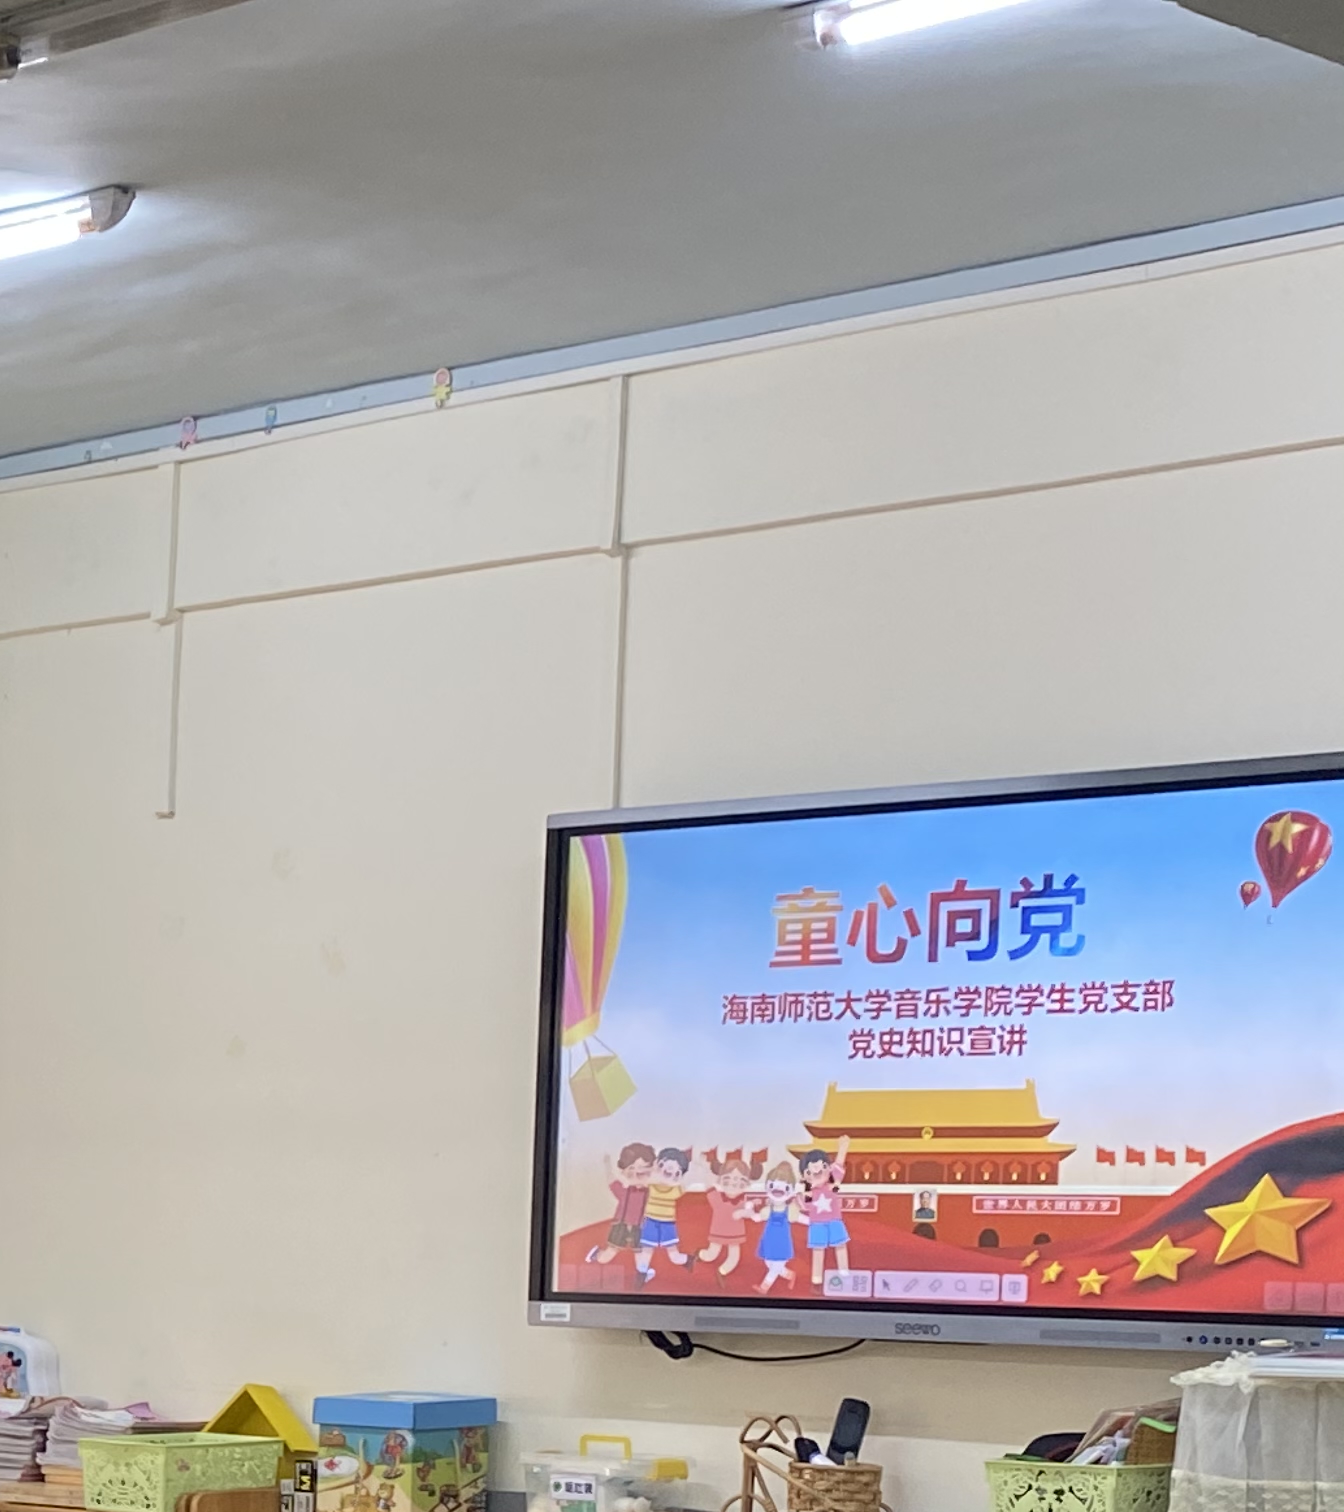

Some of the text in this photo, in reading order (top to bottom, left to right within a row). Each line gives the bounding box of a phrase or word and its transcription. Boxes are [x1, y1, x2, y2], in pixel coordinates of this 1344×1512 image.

[769, 873, 1086, 968] 童心向党
[721, 979, 1176, 1025] 海南师范大学音乐学院学生党支部
[847, 1024, 1028, 1060] 党史知识宣讲
[983, 1199, 1112, 1212] 世界人民大团结万岁
[894, 1322, 941, 1336] seewo
